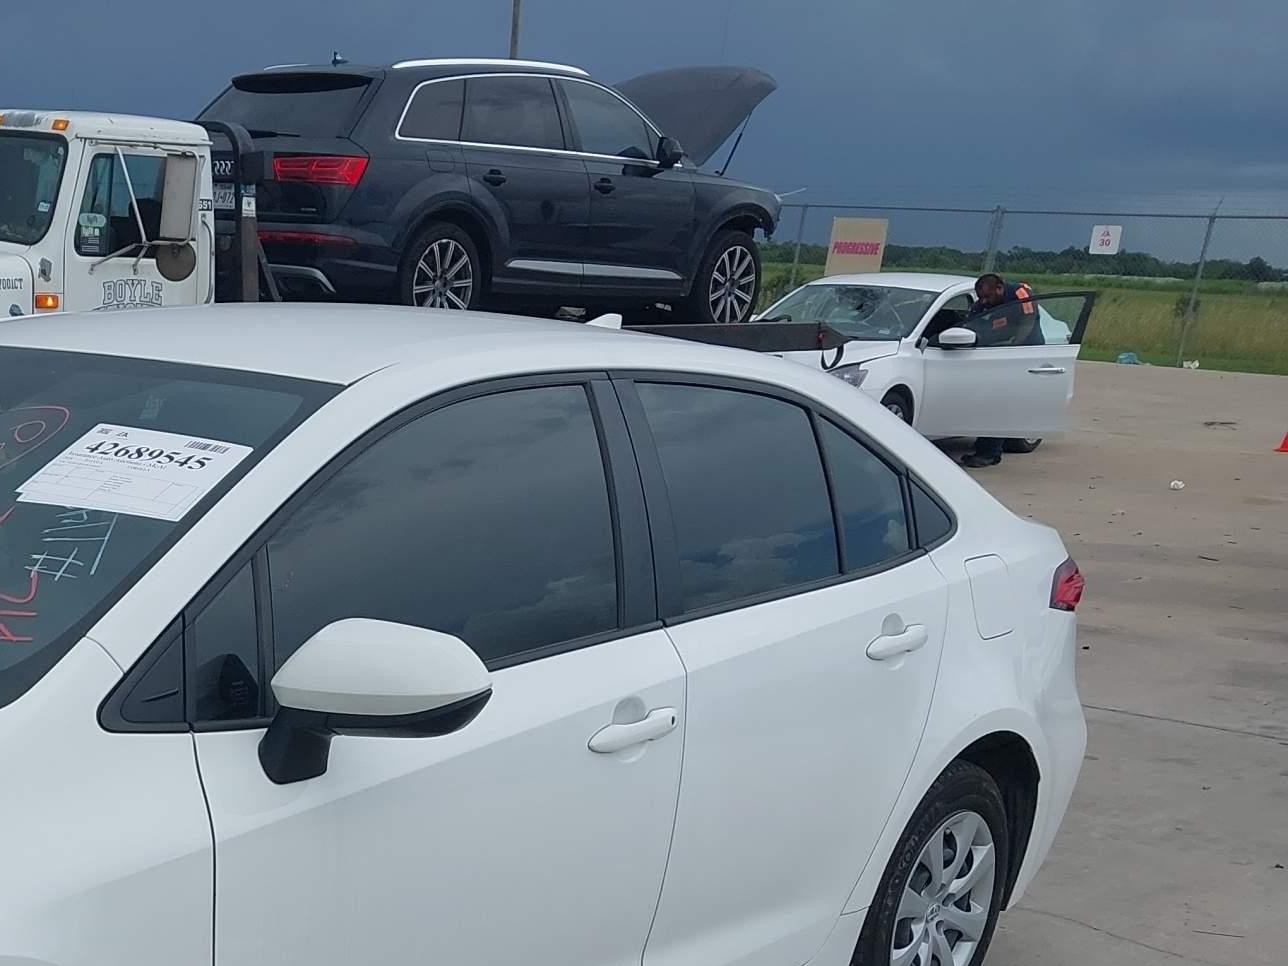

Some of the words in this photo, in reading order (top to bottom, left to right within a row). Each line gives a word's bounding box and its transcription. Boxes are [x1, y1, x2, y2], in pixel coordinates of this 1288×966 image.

[1099, 239, 1111, 247] 30
[102, 278, 163, 307] BOYLE
[85, 440, 213, 470] 42689545
[23, 506, 114, 582] #114
